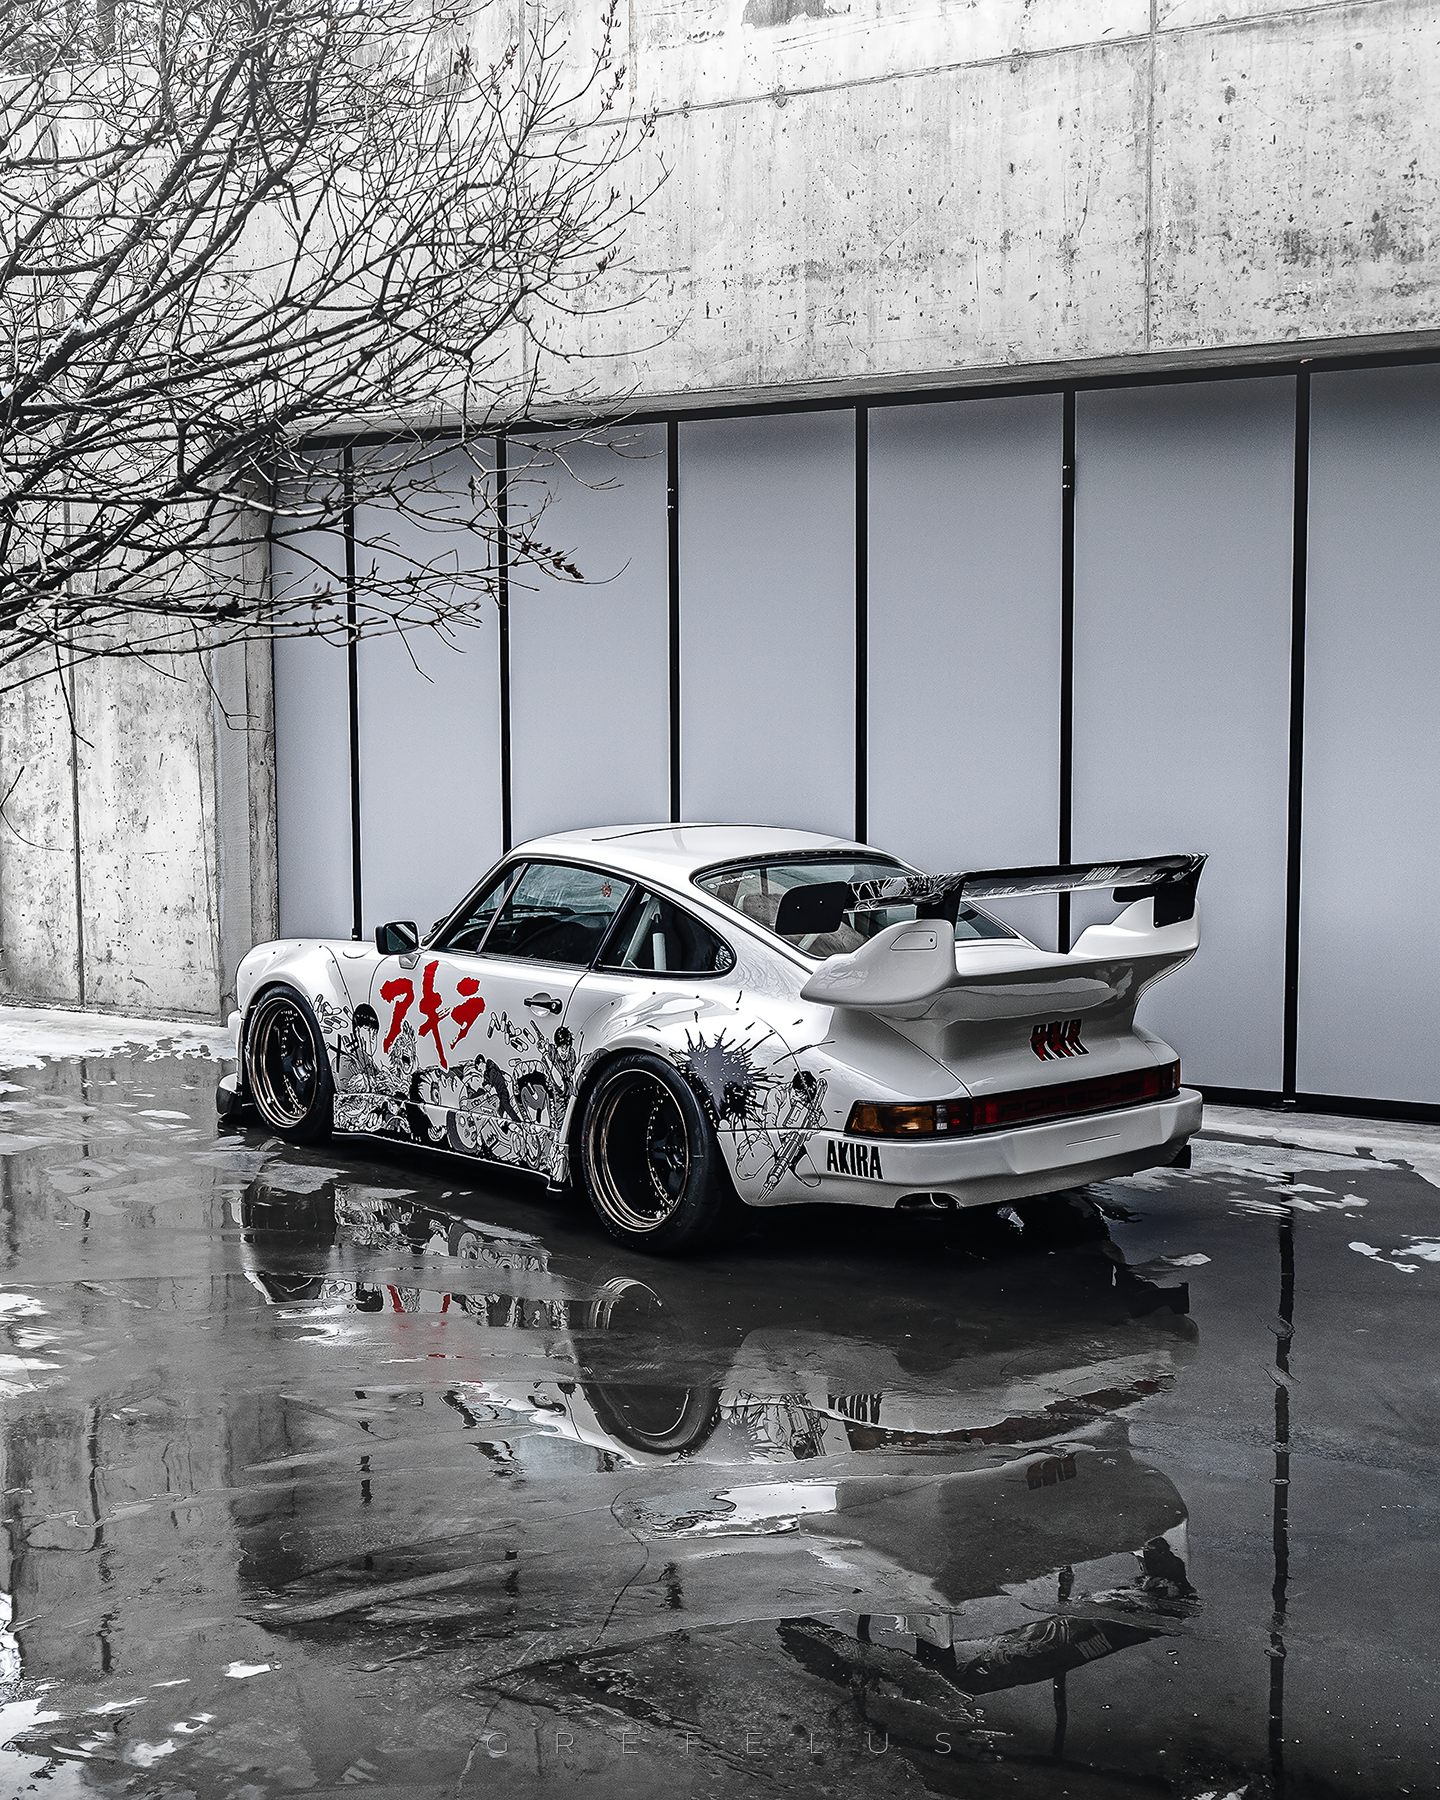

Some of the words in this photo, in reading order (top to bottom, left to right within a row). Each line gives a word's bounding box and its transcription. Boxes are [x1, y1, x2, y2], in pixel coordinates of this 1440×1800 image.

[1080, 866, 1120, 881] AKIRA
[380, 960, 485, 1070] アキラ
[1002, 1080, 1143, 1117] PORSCHE
[826, 1139, 884, 1180] AKIRA
